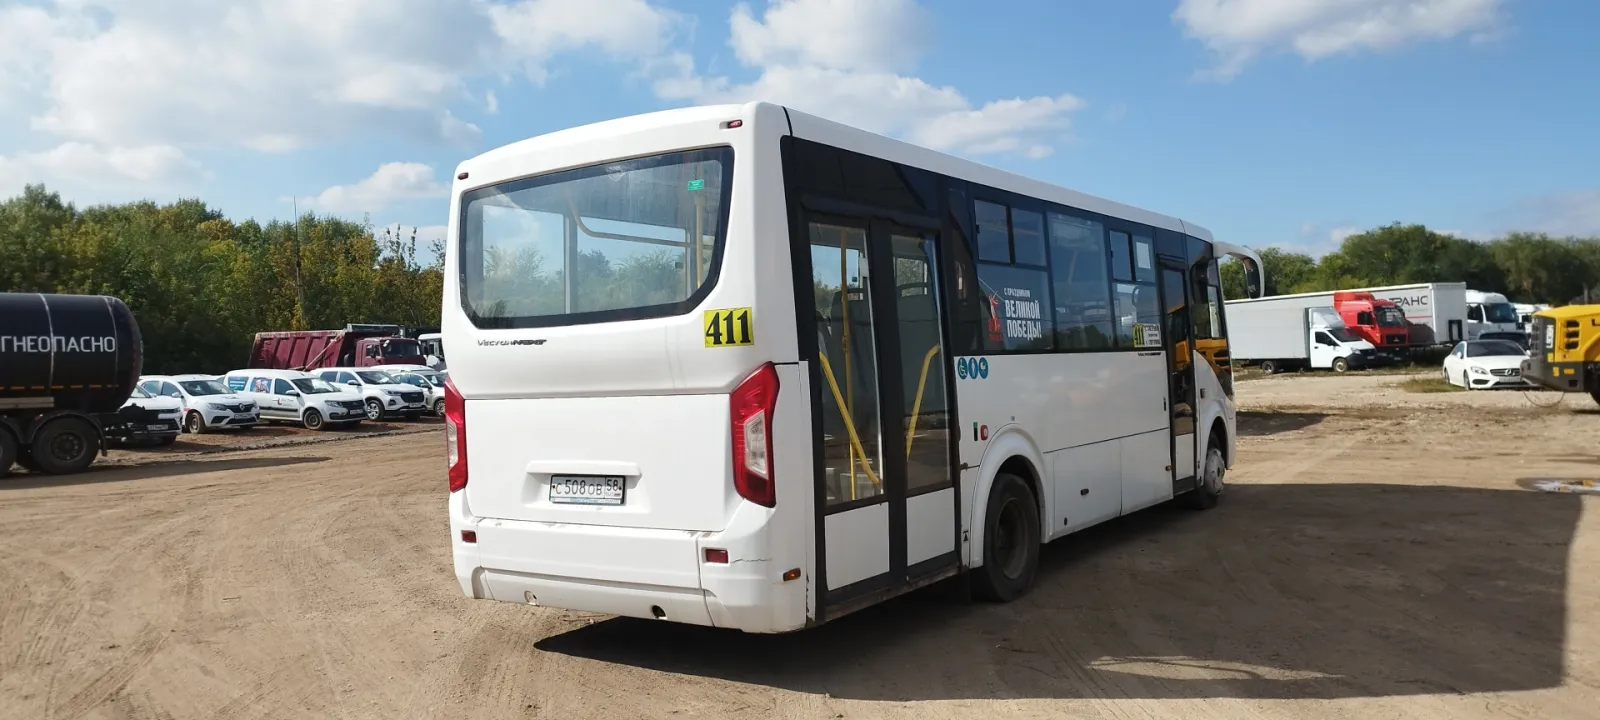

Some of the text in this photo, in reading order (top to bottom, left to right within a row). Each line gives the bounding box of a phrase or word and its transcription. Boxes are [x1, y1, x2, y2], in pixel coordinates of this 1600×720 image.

[1005, 300, 1040, 319] ВЕЛИКОЙ
[706, 310, 751, 345] 411
[1007, 320, 1042, 341] ПОБЕДЫ!
[1134, 325, 1145, 346] 411
[1, 336, 116, 352] ГНЕОПАСНО
[606, 479, 619, 491] 58
